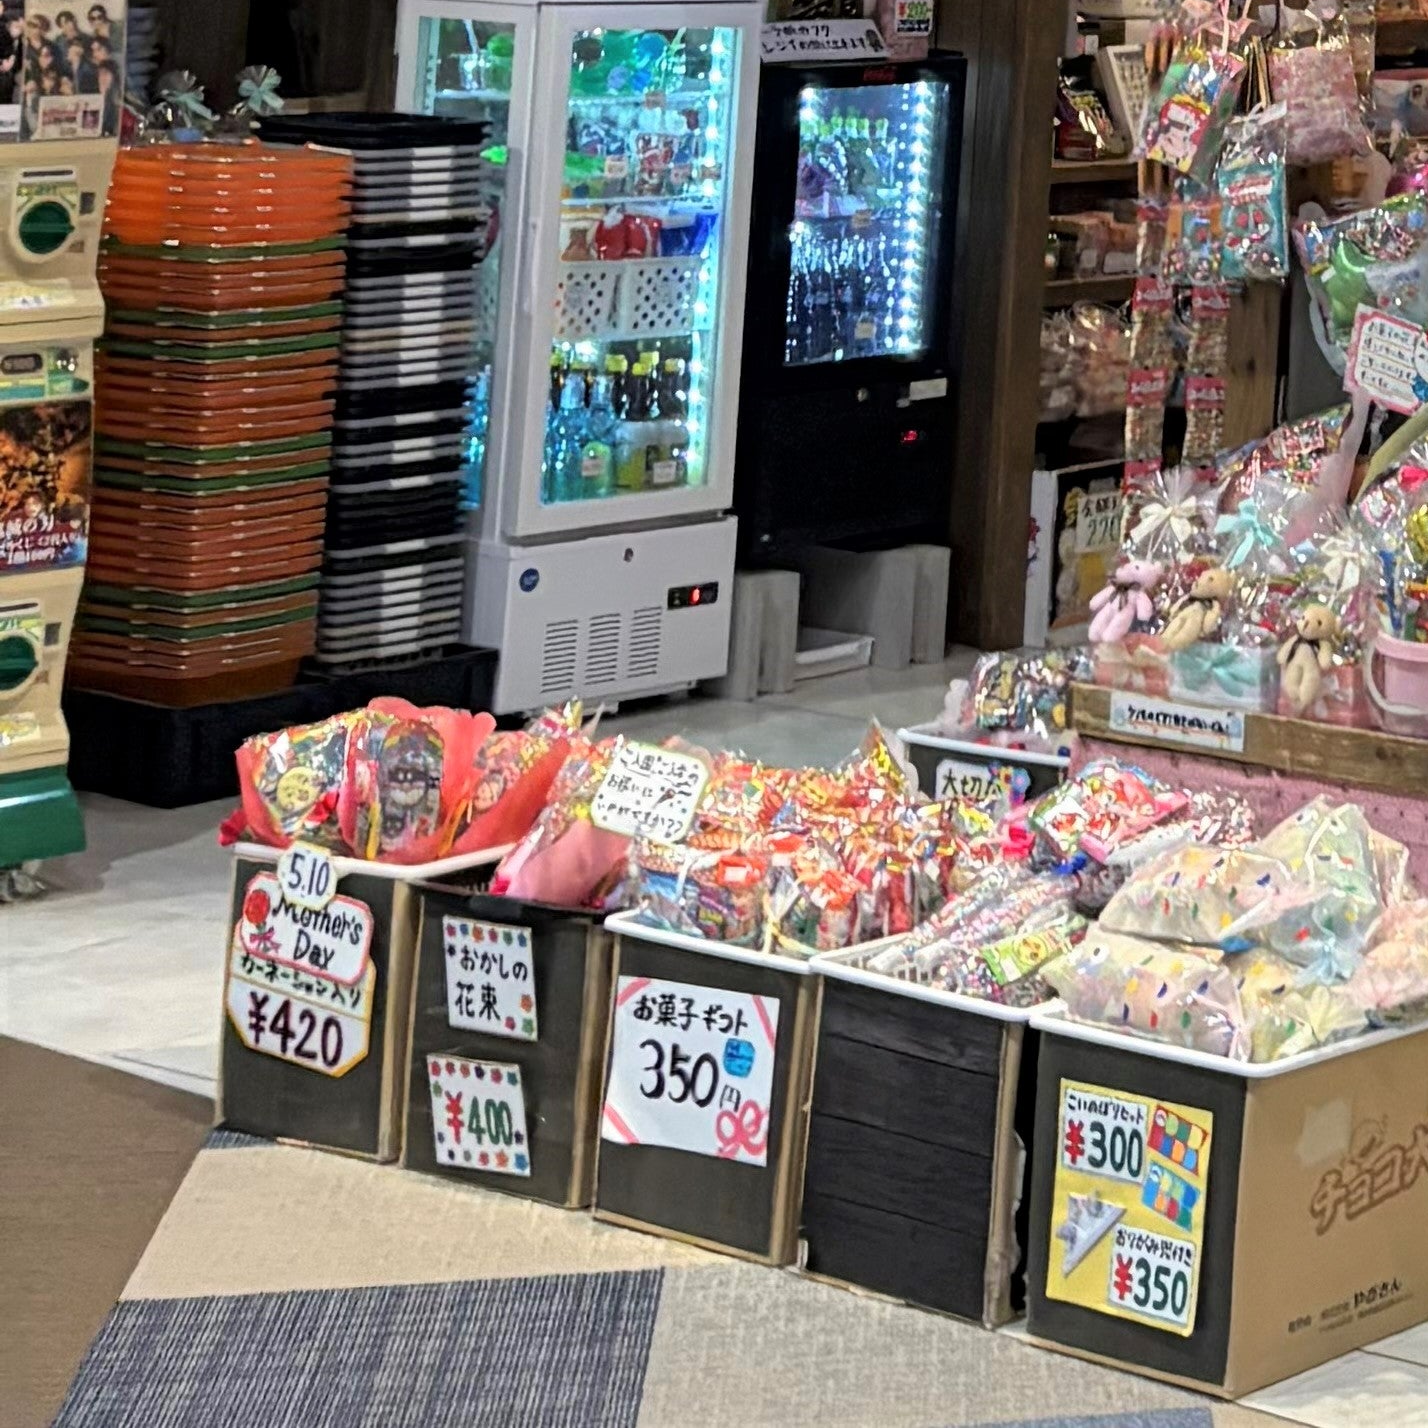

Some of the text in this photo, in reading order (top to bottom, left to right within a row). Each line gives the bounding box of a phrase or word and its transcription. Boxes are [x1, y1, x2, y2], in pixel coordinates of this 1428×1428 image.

[288, 853, 331, 896] 5.10
[293, 930, 335, 972] Day
[460, 945, 529, 983] おかしの
[248, 991, 344, 1068] ¥420
[632, 994, 748, 1036] お菓子ギフト
[445, 1091, 513, 1145] ¥400
[1064, 1118, 1144, 1178] ¥300
[1113, 1251, 1189, 1317] ¥350
